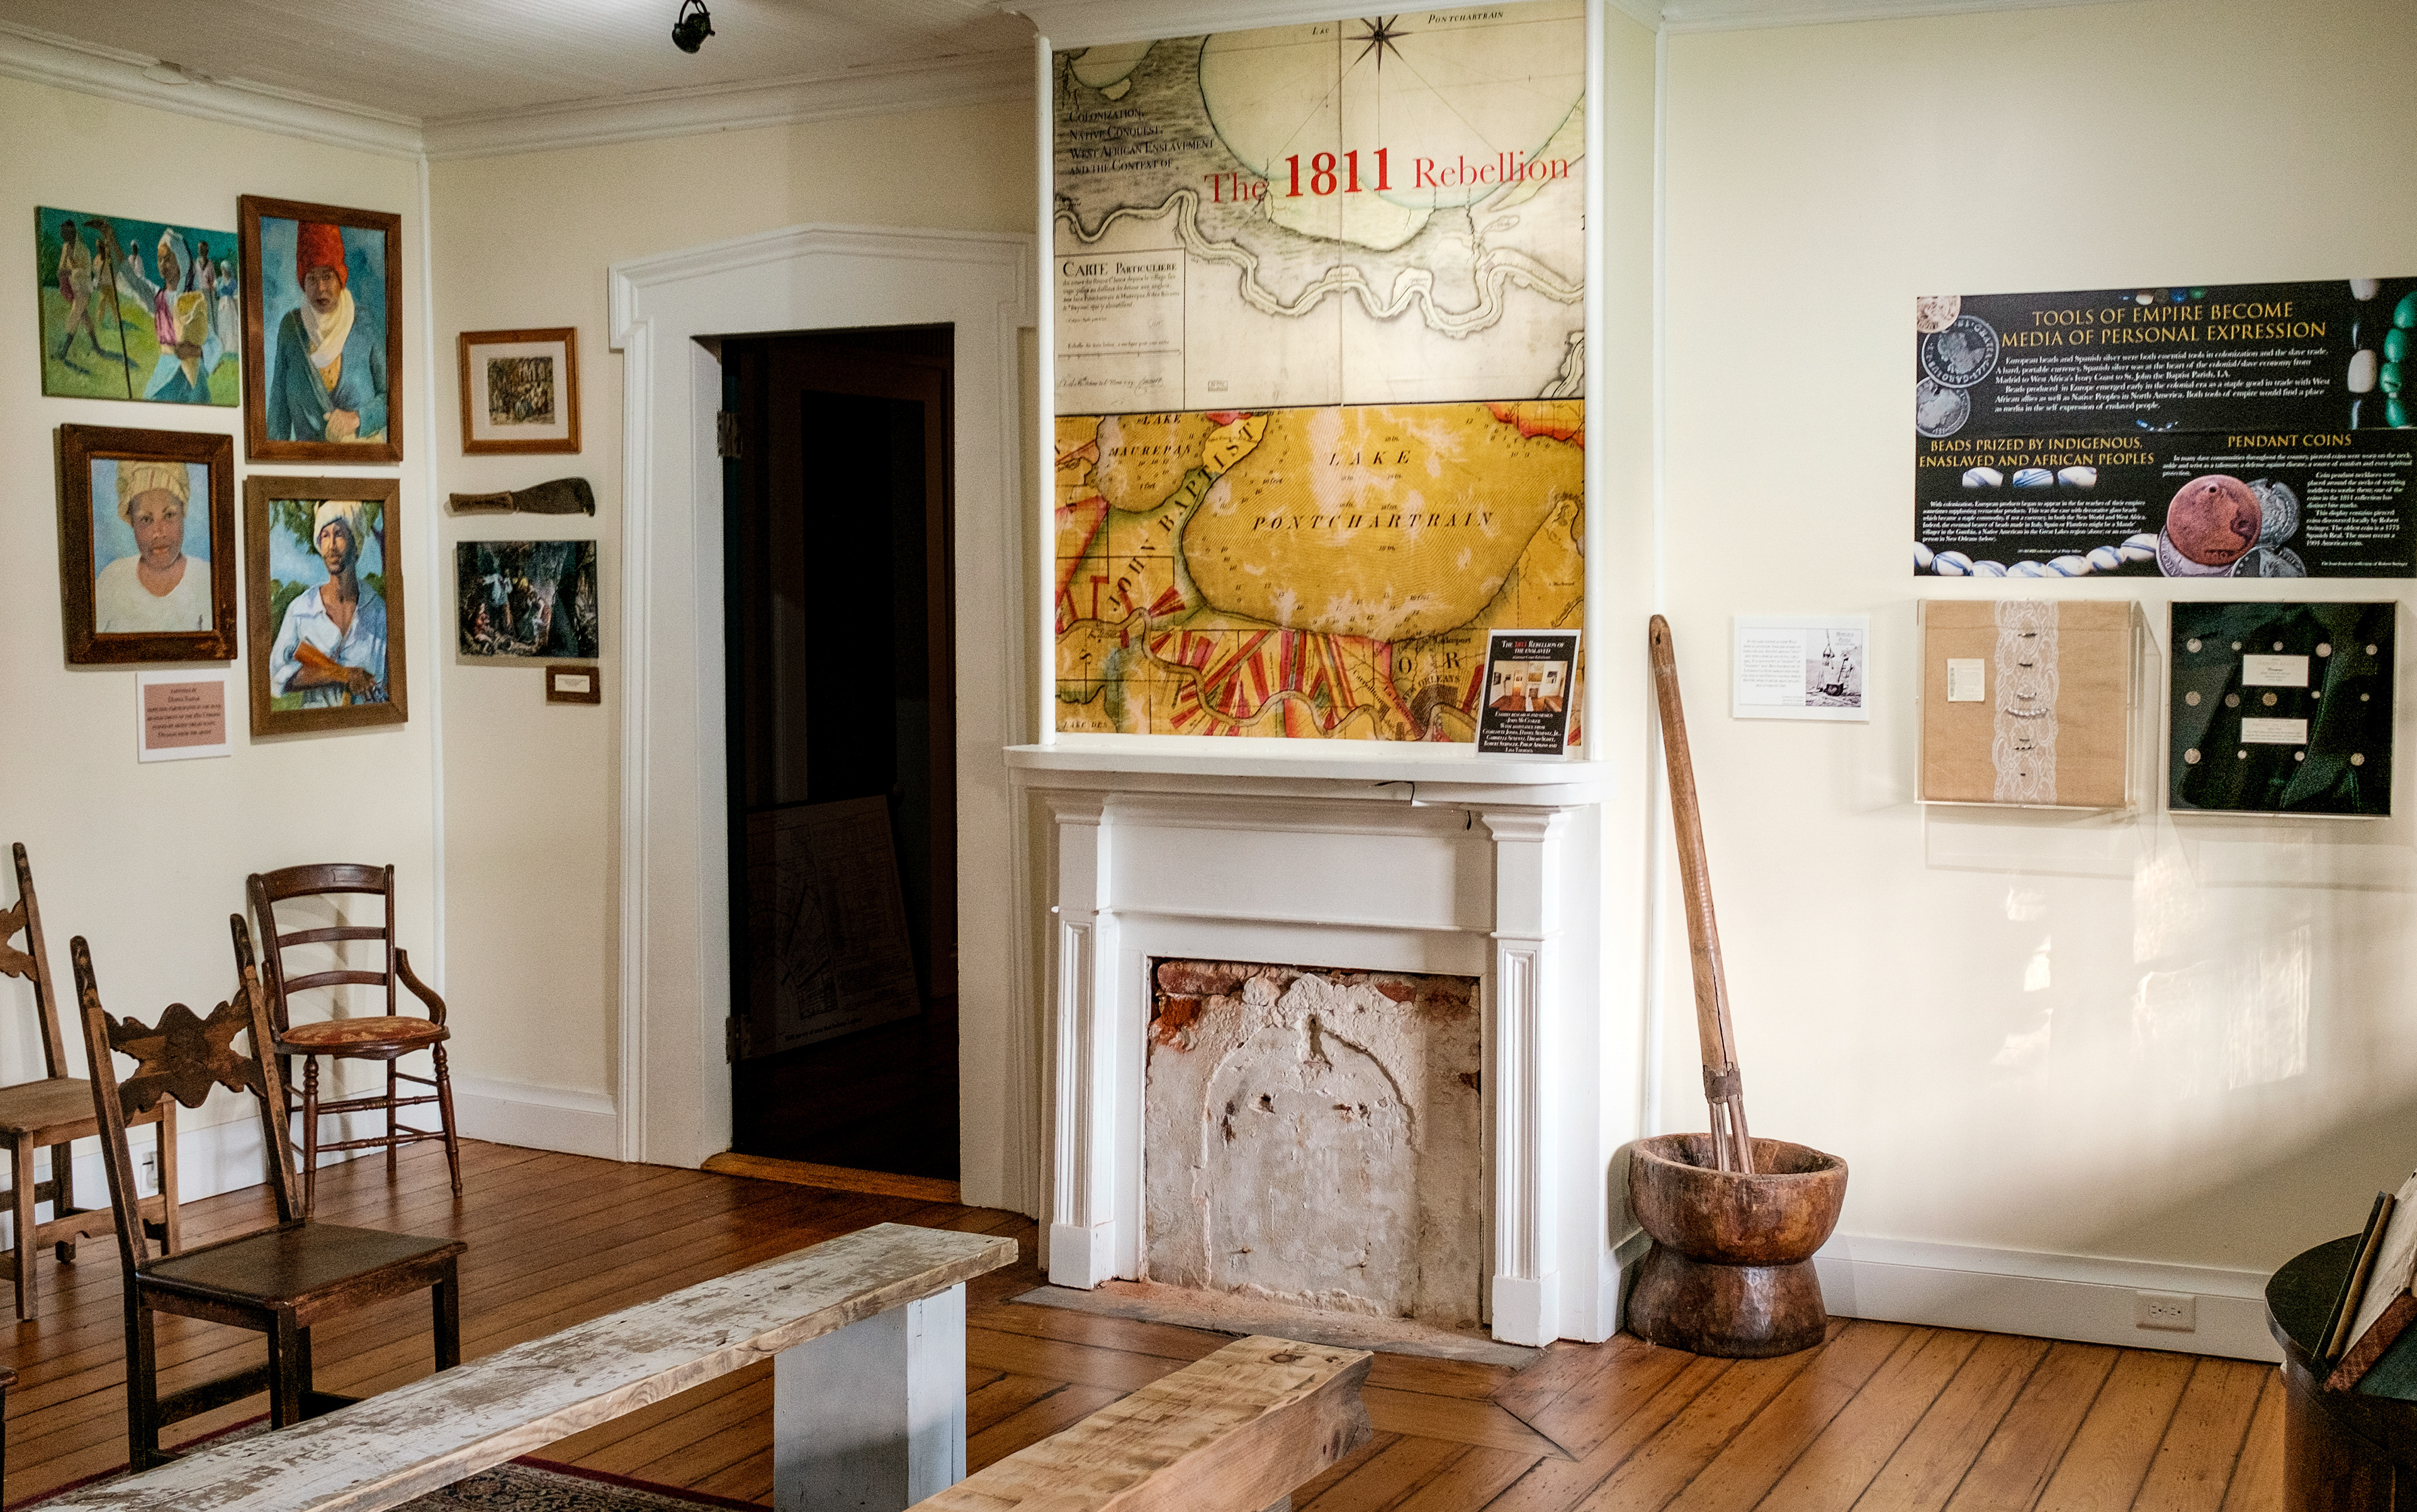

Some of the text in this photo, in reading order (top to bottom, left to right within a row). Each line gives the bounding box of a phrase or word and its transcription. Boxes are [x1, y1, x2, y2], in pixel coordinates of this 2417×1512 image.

[1427, 11, 1504, 25] PONTCHARTRAIN
[1069, 138, 1214, 159] WEST AFRICAN ENSLAVEMENT
[1069, 158, 1173, 175] AND THE CONTEXT OF
[1204, 147, 1570, 203] The 1811 Rebellion
[1062, 261, 1109, 278] CARTE
[1116, 262, 1178, 274] PARTICULIERE
[2031, 301, 2294, 326] TOOLS OF EMPIRE BECOME
[2002, 322, 2326, 347] MEDIA OF PERSONAL EXPRESSION
[2006, 356, 2038, 366] European
[2039, 355, 2059, 364] beads
[2060, 354, 2073, 363] and
[2075, 354, 2102, 364] Spanish
[2189, 351, 2205, 359] tools
[2206, 350, 2214, 358] in
[2214, 349, 2258, 358] colonization
[2259, 348, 2274, 356] and
[2275, 348, 2287, 356] the
[1995, 366, 2002, 375] A
[2083, 363, 2110, 374] Spanish
[2186, 361, 2195, 369] of
[2196, 360, 2208, 368] the
[1995, 376, 2021, 384] Madrid
[2031, 375, 2046, 383] West
[2134, 372, 2152, 381] John
[2166, 371, 2190, 381] Baptist
[2005, 385, 2026, 393] Beads
[2026, 385, 2058, 395] produced
[2061, 383, 2069, 392] in
[2070, 383, 2095, 393] Europe
[2095, 382, 2126, 392] emerged
[2127, 381, 2144, 392] early
[2145, 381, 2153, 390] in
[2154, 381, 2166, 389] the
[2265, 378, 2273, 386] in
[2274, 378, 2294, 386] trade
[2295, 378, 2312, 386] with
[2313, 377, 2330, 385] West
[1995, 395, 2020, 403] African
[2048, 393, 2061, 402] well
[2122, 392, 2130, 400] in
[2131, 392, 2152, 400] North
[2186, 390, 2204, 398] Both
[2204, 390, 2222, 398] tools
[2223, 388, 2232, 397] of
[2233, 388, 2258, 399] empire
[2259, 388, 2282, 397] would
[2283, 387, 2298, 396] find
[2305, 387, 2325, 398] place
[2025, 403, 2033, 412] in
[2034, 403, 2046, 412] the
[2095, 402, 2105, 410] of
[2105, 402, 2134, 410] enslaved
[1143, 414, 1181, 426] LAKE
[1930, 437, 2143, 452] BEADS PRIZED BY INDIGENOUS,
[2228, 433, 2352, 448] PENDANT COINS
[1329, 450, 1411, 466] LAKE
[1919, 453, 2156, 468] ENASLAVED AND AFRICAN PEOPLES
[1253, 511, 1494, 531] PONTCHARTRAIN
